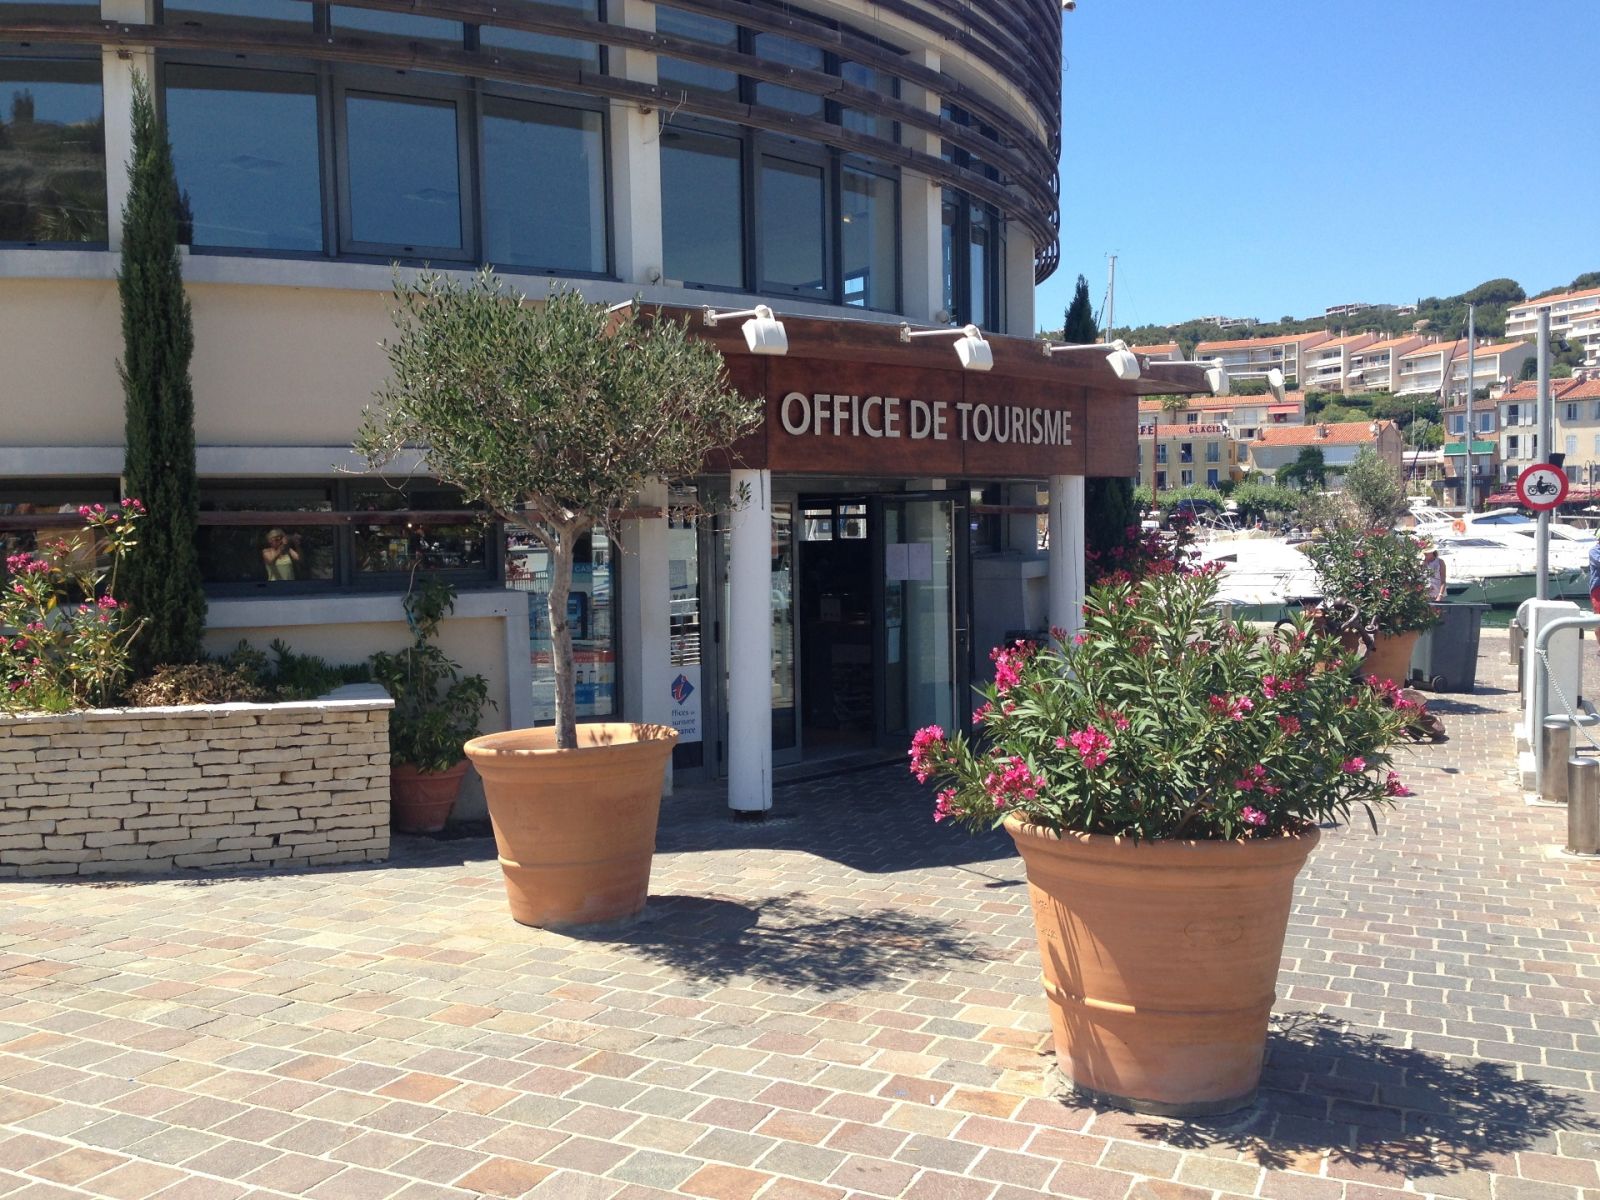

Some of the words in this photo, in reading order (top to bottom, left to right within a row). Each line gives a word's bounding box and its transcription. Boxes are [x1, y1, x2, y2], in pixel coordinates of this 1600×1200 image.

[781, 391, 901, 438] OFFICE
[910, 399, 948, 441] DE
[956, 402, 1073, 446] TOURISME
[1189, 424, 1228, 434] GLACIER
